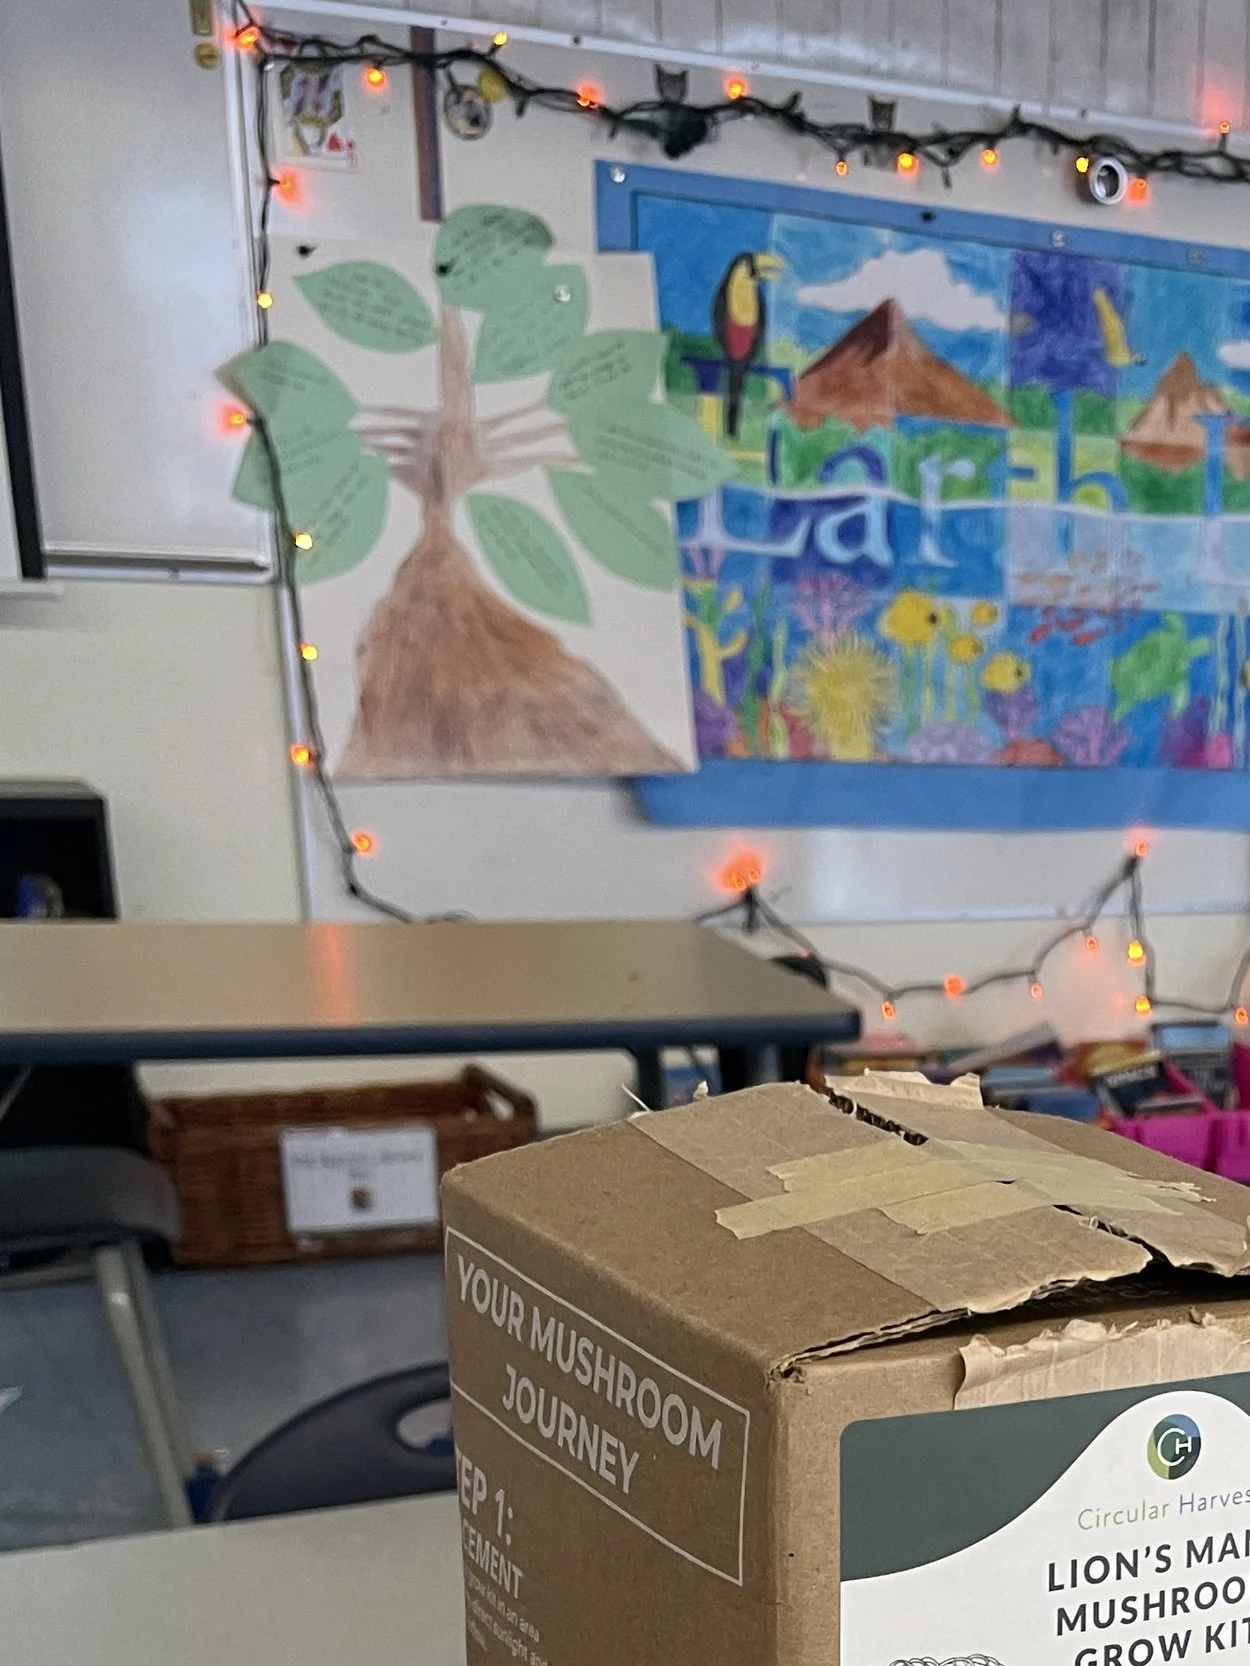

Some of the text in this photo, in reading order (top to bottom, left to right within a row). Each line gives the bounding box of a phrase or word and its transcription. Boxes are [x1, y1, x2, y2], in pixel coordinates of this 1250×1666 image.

[457, 1254, 722, 1470] YOUR MUSHROOM
[502, 1364, 639, 1494] JOURNEY
[456, 1448, 487, 1515] EP
[1077, 1499, 1170, 1531] Circular
[463, 1518, 523, 1600] CEMENT
[506, 1604, 518, 1627] an
[519, 1616, 541, 1643] area
